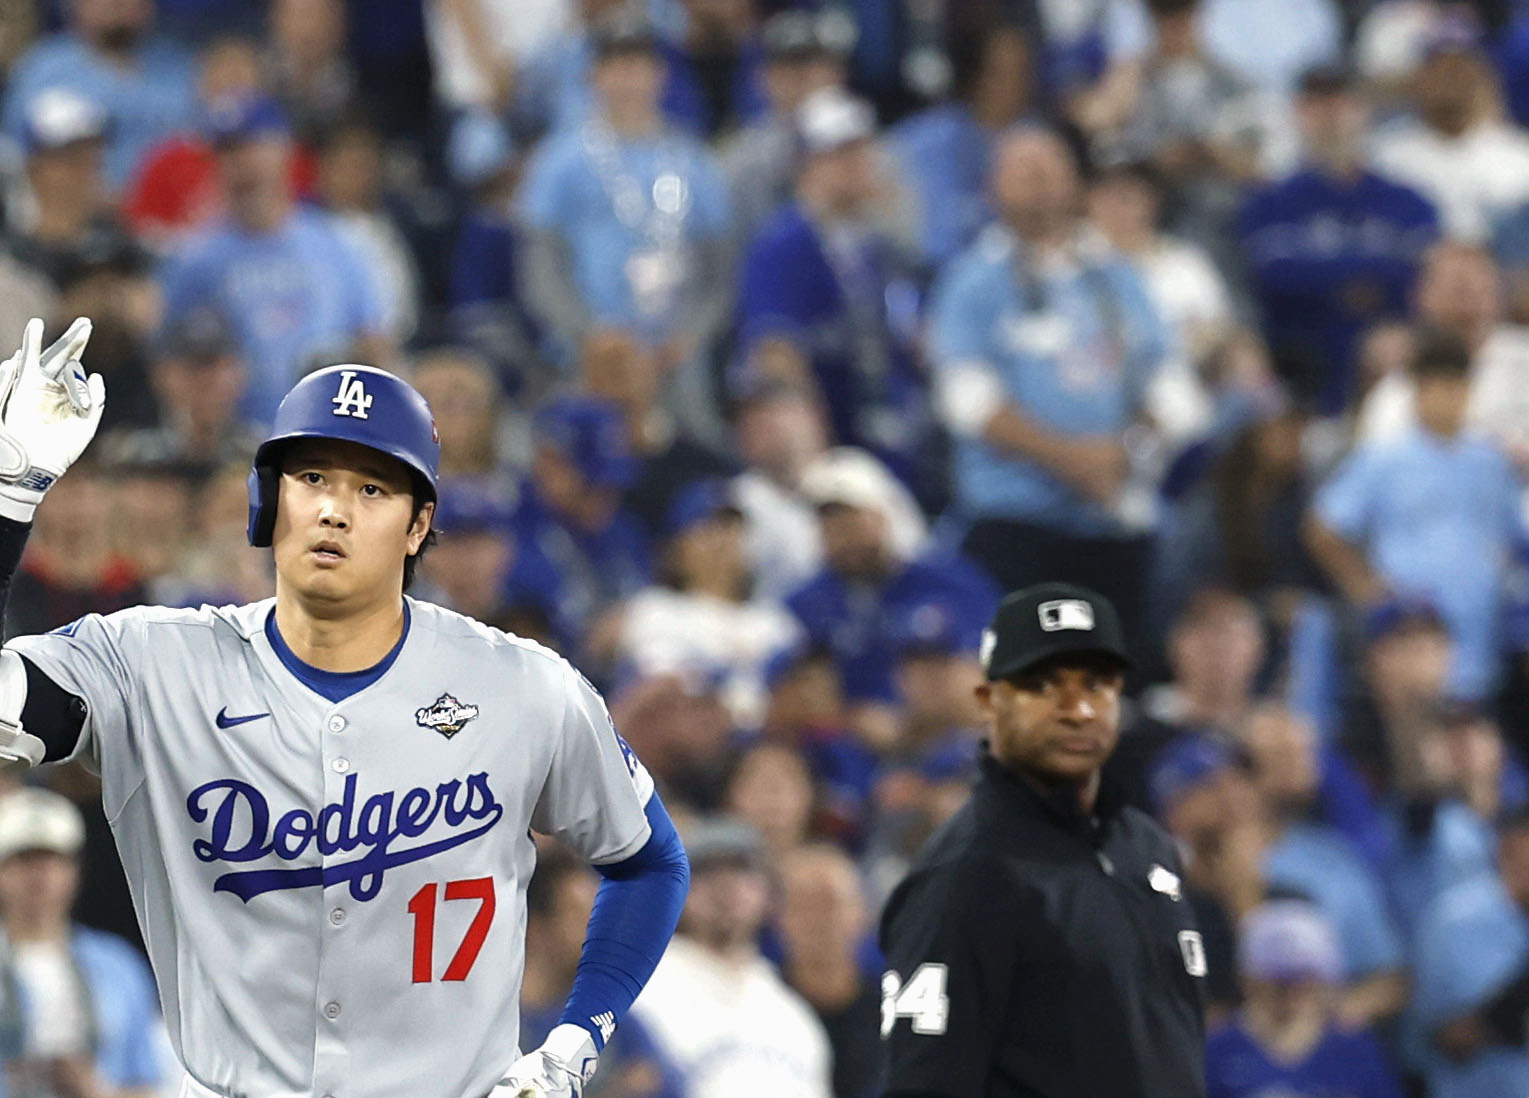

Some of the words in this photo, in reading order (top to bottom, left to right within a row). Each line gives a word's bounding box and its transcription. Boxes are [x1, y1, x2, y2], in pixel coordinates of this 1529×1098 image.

[332, 371, 373, 420] LA
[186, 771, 503, 903] Dodgers
[408, 876, 496, 984] 17
